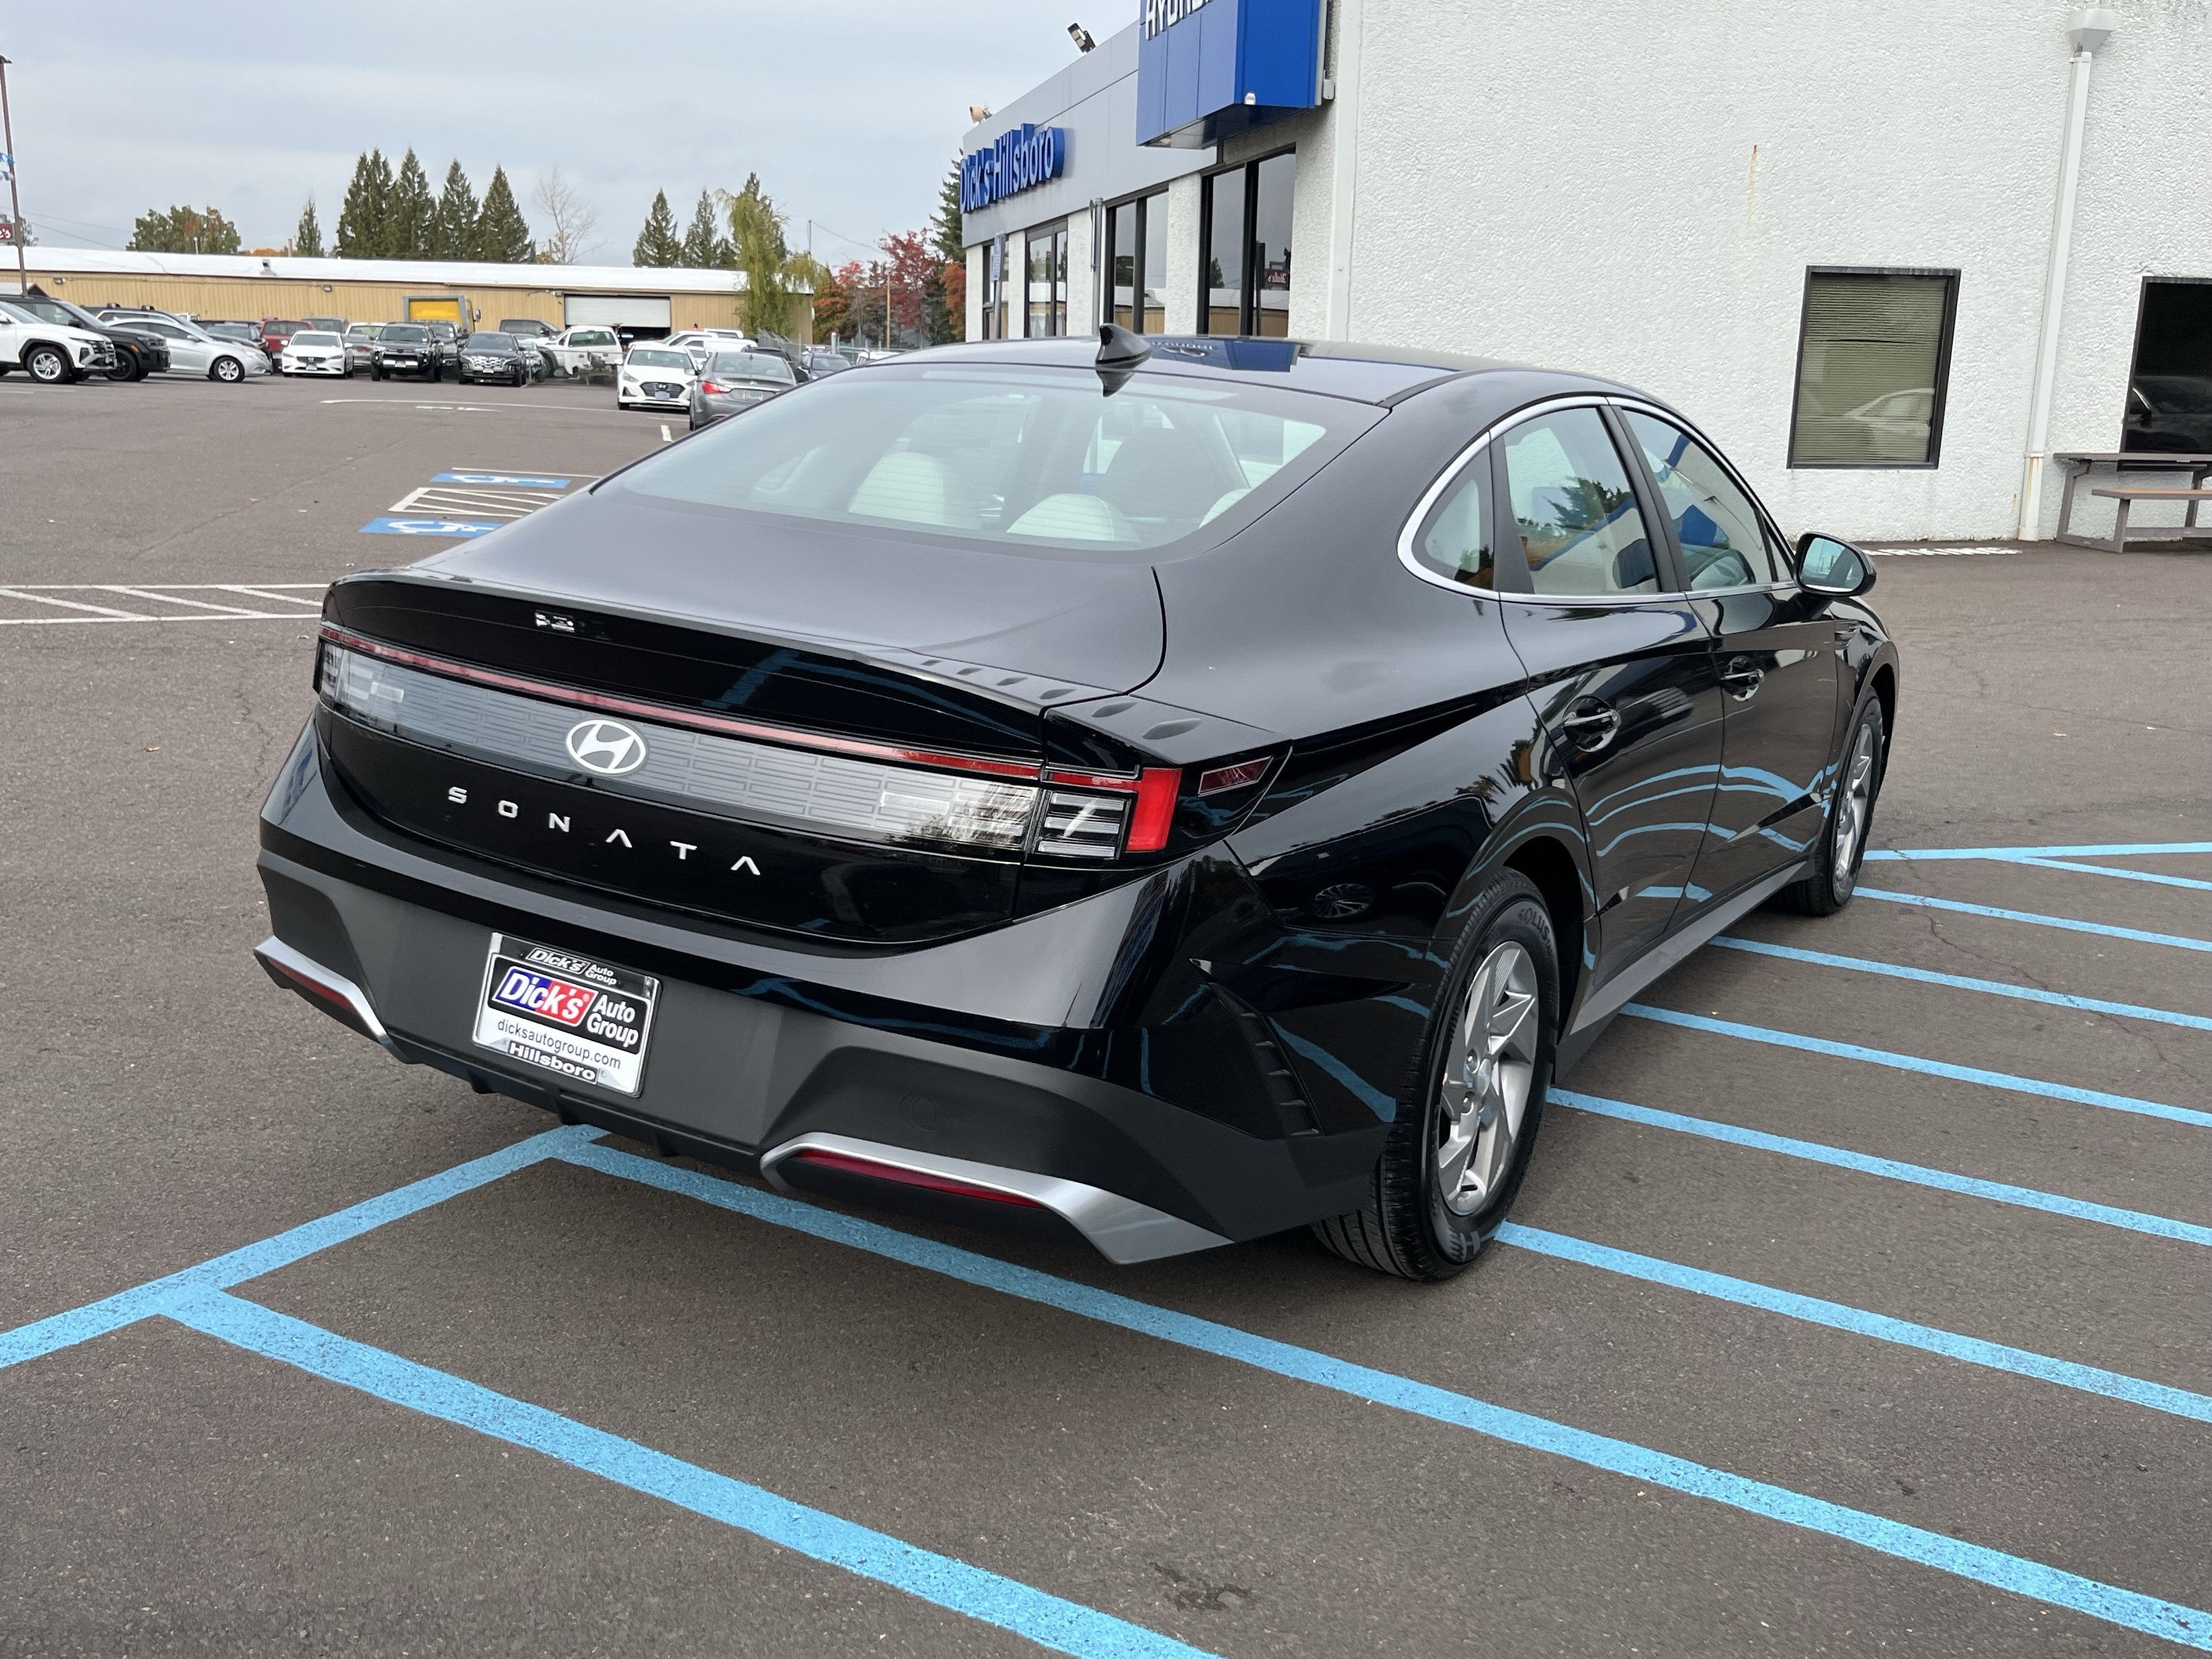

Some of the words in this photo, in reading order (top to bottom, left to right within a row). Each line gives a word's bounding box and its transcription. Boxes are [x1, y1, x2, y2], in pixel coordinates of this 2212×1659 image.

[960, 148, 990, 214] Dick's
[994, 123, 1054, 201] Hillsboro
[447, 786, 761, 876] SONATA
[531, 950, 584, 972] Dick's
[585, 970, 618, 985] Group
[589, 964, 614, 977] Auto
[500, 972, 584, 1020] Dick's
[592, 994, 635, 1023] Auto
[497, 1018, 621, 1070] dicksautogroup.com
[586, 1013, 640, 1047] Group
[509, 1043, 596, 1081] Hillsboro
